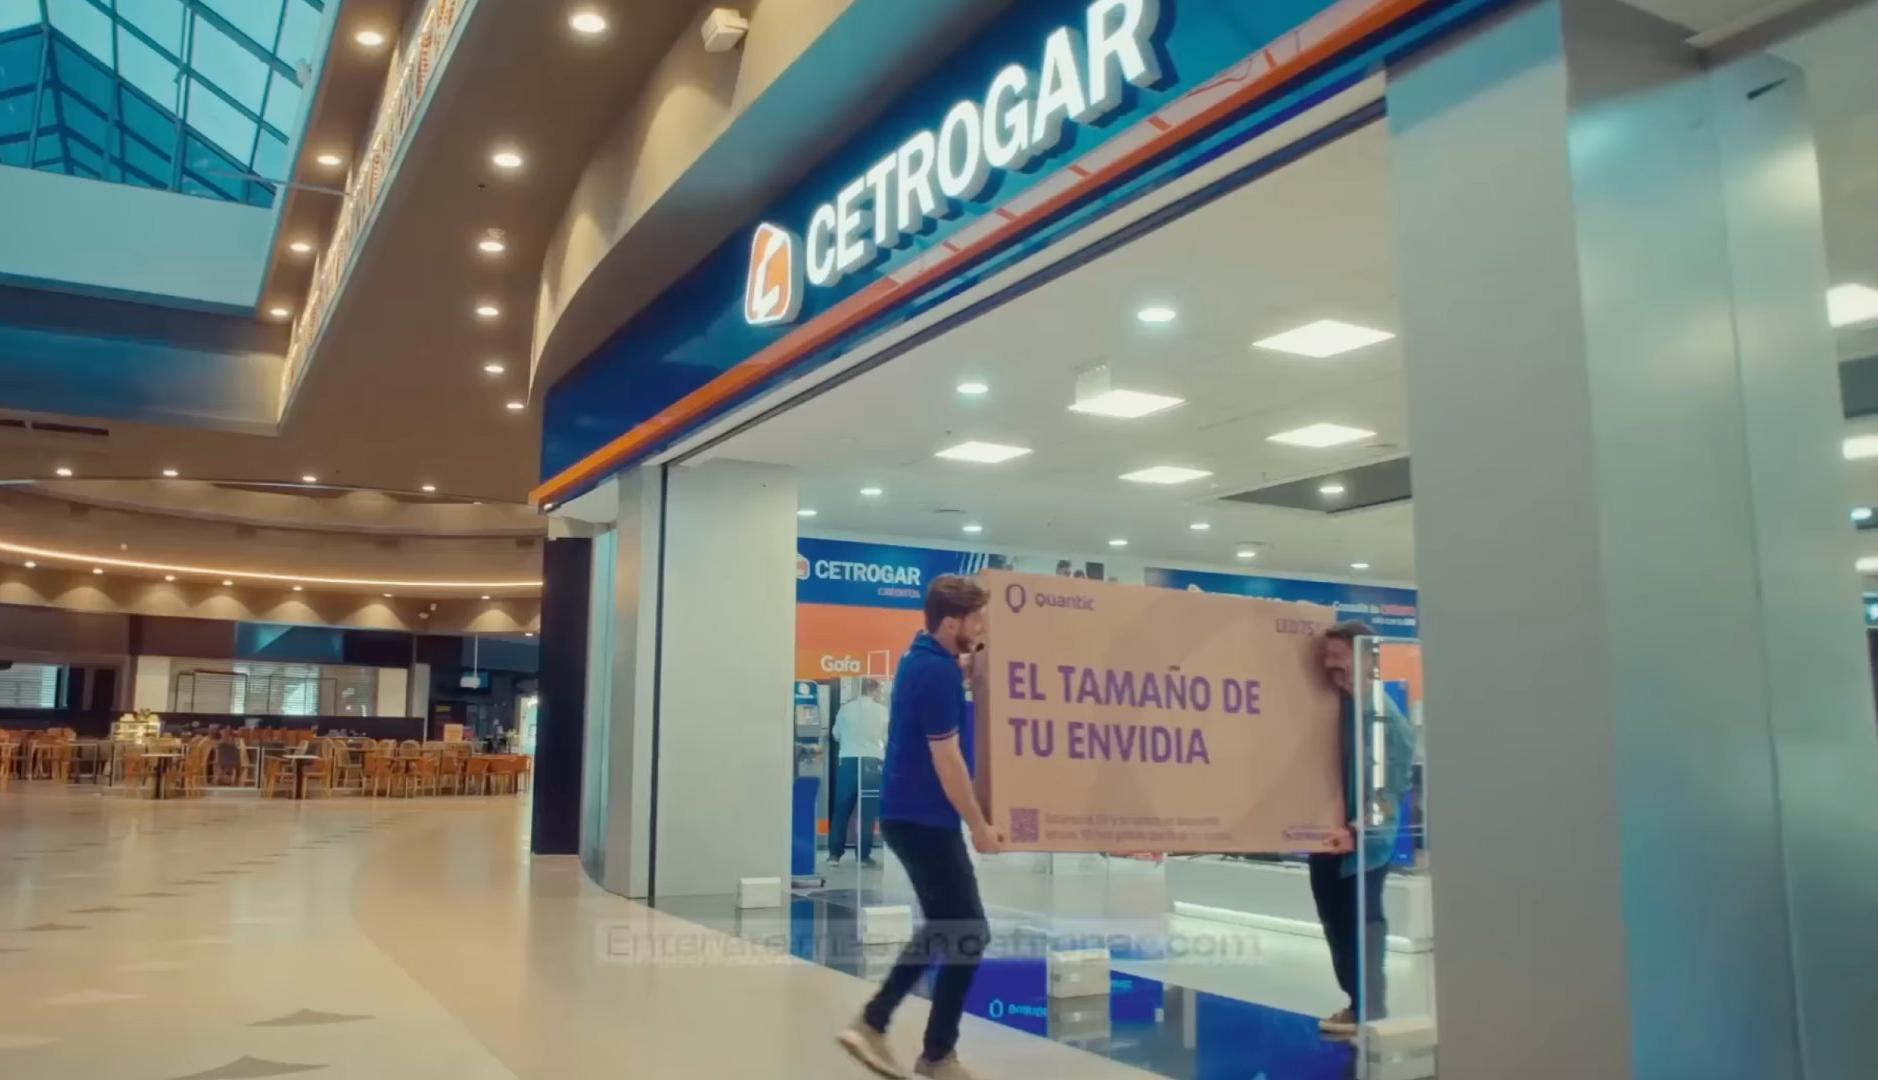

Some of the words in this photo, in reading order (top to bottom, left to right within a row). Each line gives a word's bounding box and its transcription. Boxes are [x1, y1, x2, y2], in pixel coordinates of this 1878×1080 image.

[806, 0, 1157, 286] CETROGAR
[814, 560, 921, 586] CETROGAR
[820, 655, 861, 673] Gafa
[1008, 661, 1046, 701] EL
[1057, 665, 1211, 712] TAMAÑO
[1222, 678, 1261, 715] DE
[1008, 718, 1054, 757] TU
[1068, 721, 1210, 765] ENVIDIA
